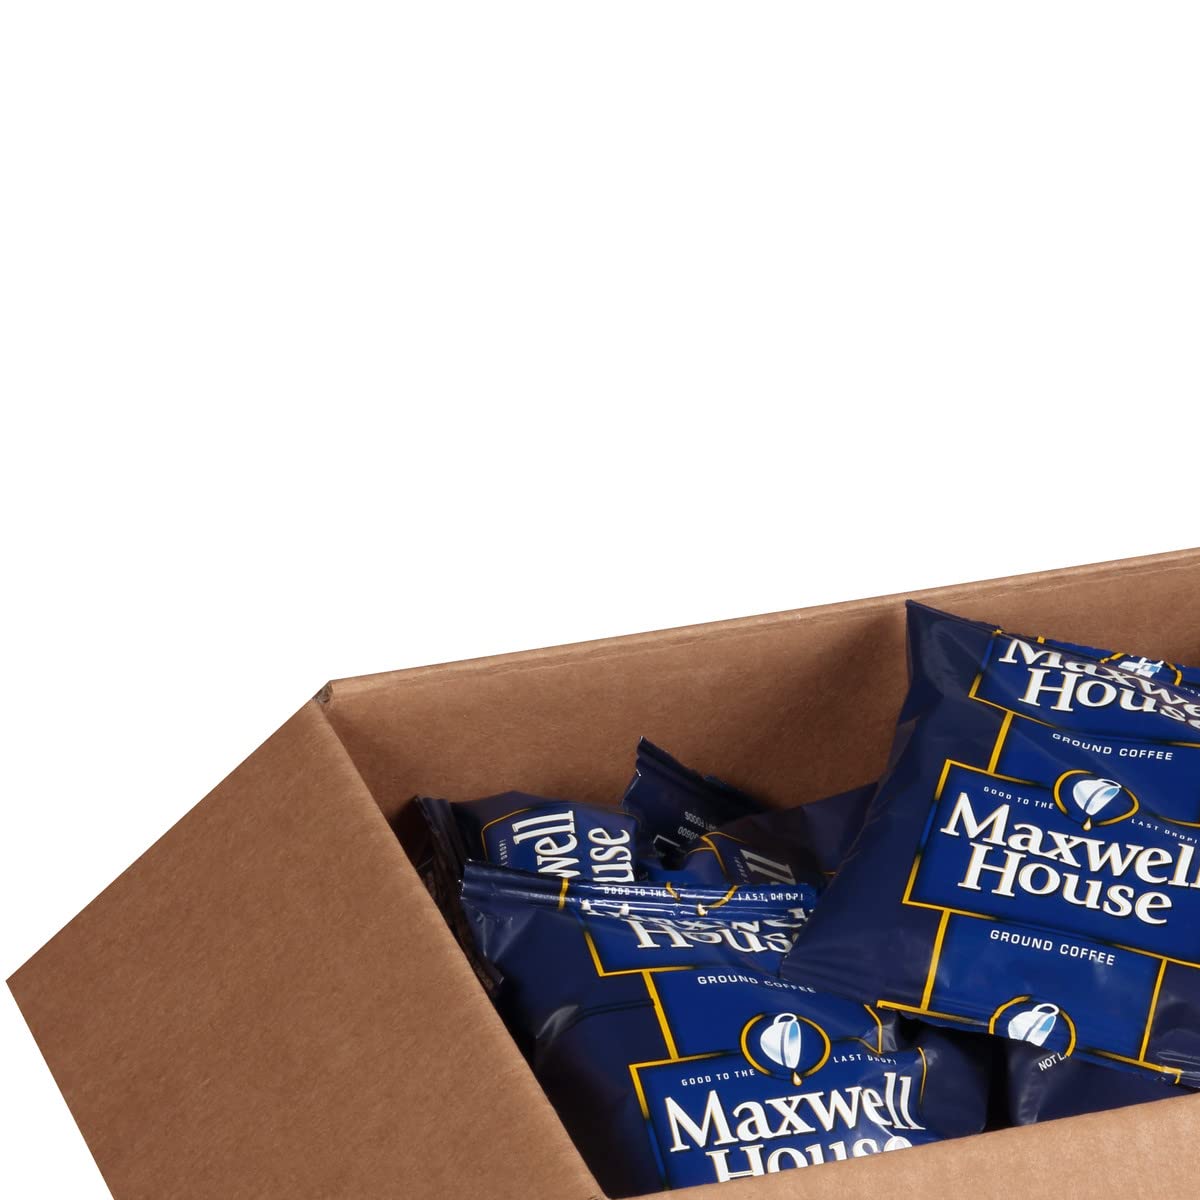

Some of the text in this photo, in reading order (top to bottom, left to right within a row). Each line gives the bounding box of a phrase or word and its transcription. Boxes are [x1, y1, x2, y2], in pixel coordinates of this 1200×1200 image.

[1052, 733, 1174, 761] GROUND COFFEE
[983, 786, 1054, 810] GOOD TO THE
[1131, 818, 1199, 844] LAST DROP!
[957, 841, 1173, 926] House
[621, 919, 799, 953] Hous
[989, 929, 1116, 967] GROUND COFFEE
[697, 974, 760, 985] GROUND
[833, 1053, 862, 1063] LAST
[1037, 1054, 1057, 1072] NOT
[681, 1069, 755, 1087] GOOD TO THE
[665, 1072, 926, 1153] Maxwell
